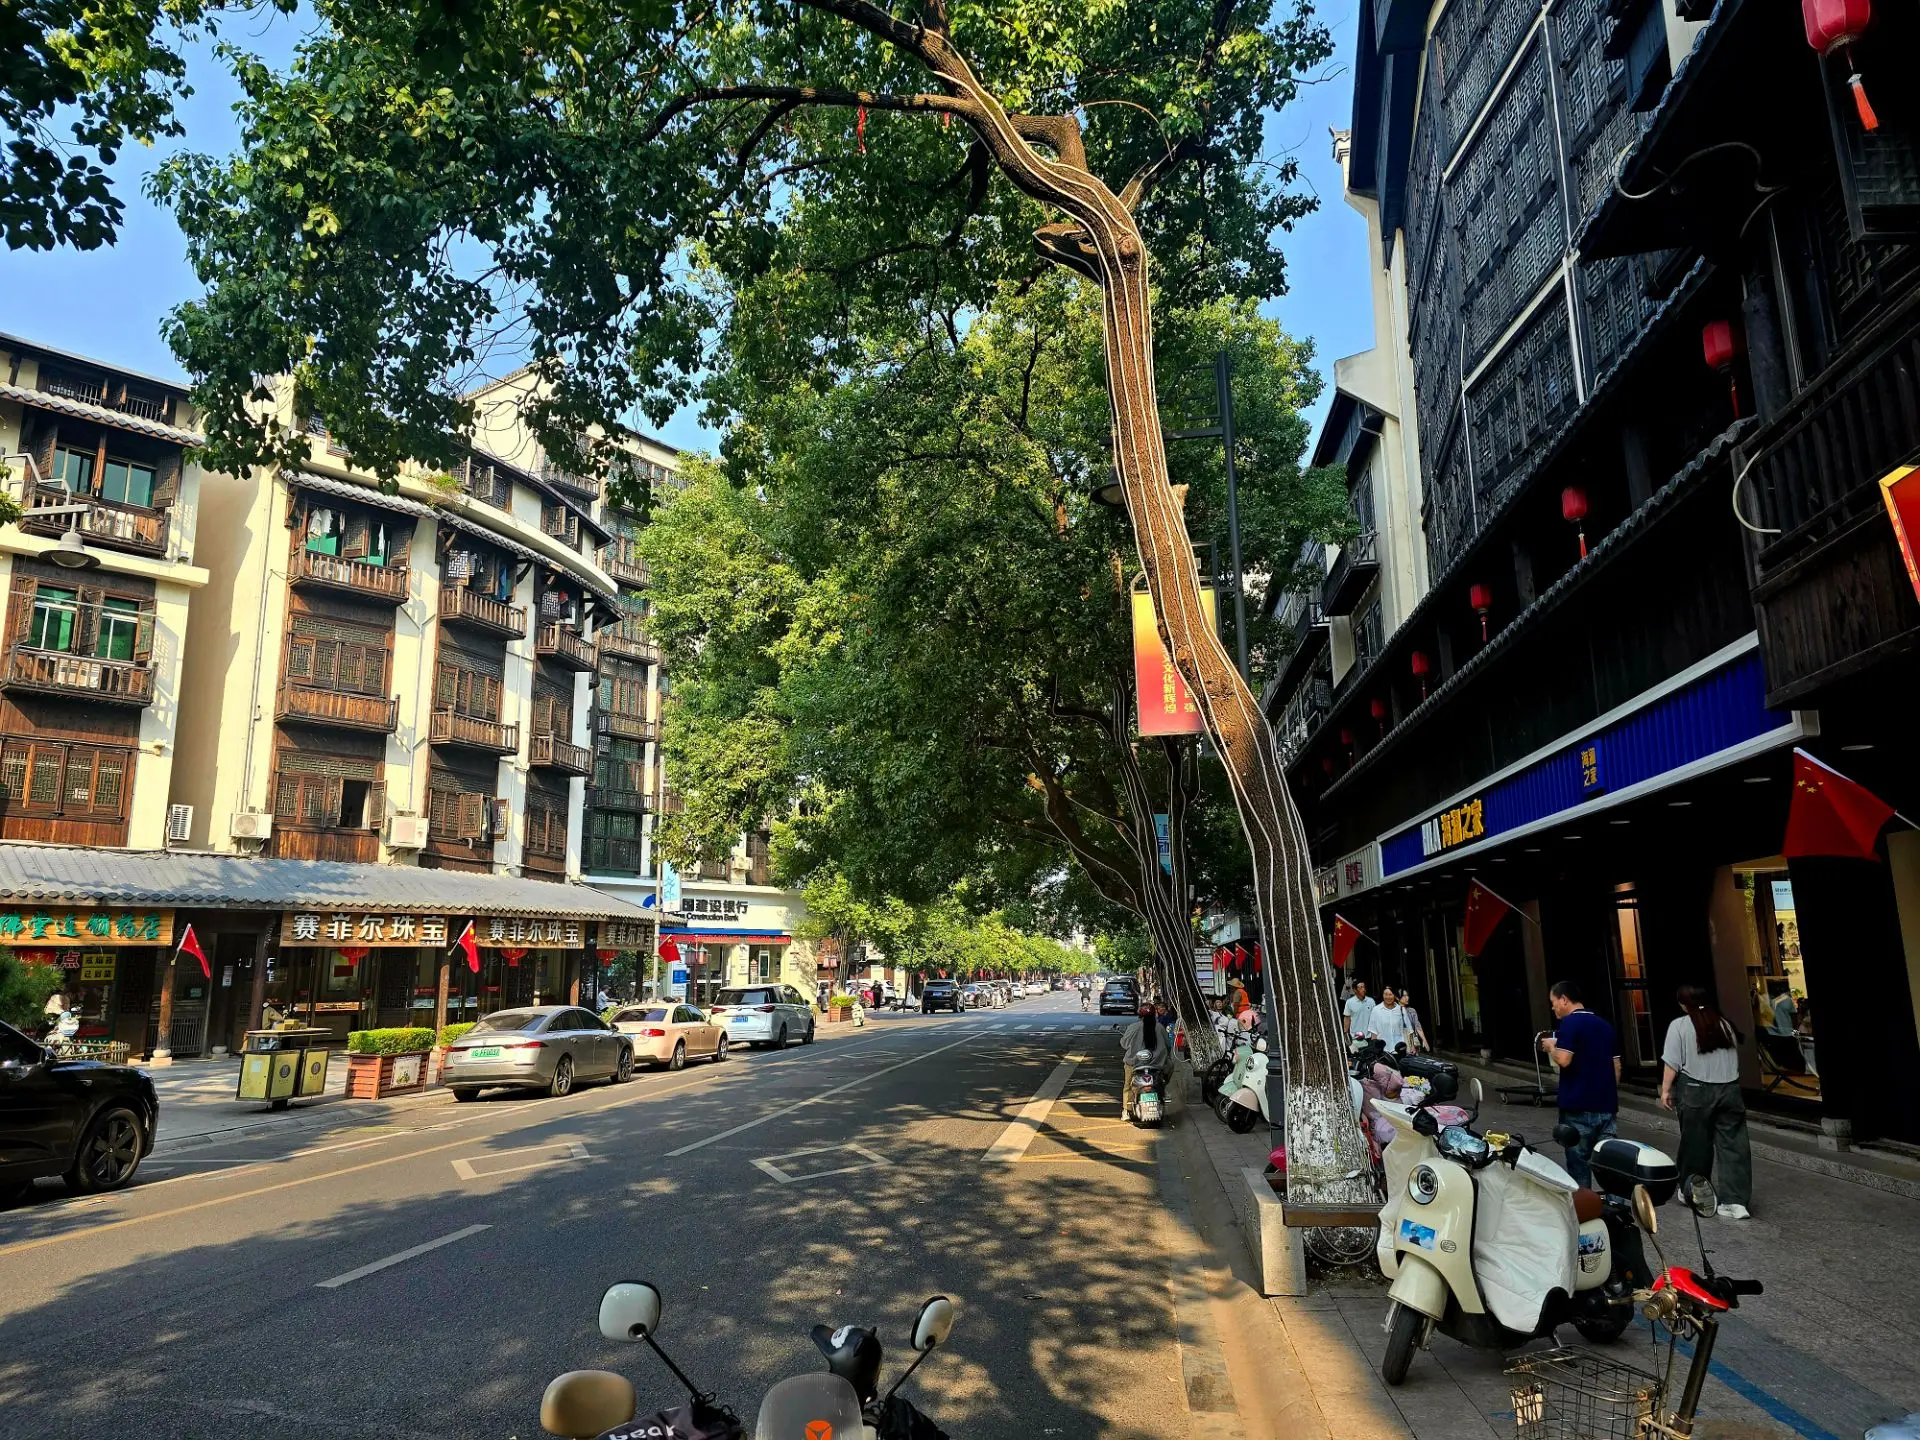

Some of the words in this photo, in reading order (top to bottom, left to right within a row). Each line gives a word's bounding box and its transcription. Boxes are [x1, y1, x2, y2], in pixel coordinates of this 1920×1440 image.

[1583, 766, 1598, 787] 之家
[1440, 798, 1484, 849] 海澜之家
[293, 912, 446, 941] 赛菲尔珠宝
[488, 917, 579, 943] 赛菲尔珠宝
[686, 912, 724, 921] Construction
[724, 913, 739, 922] Bank
